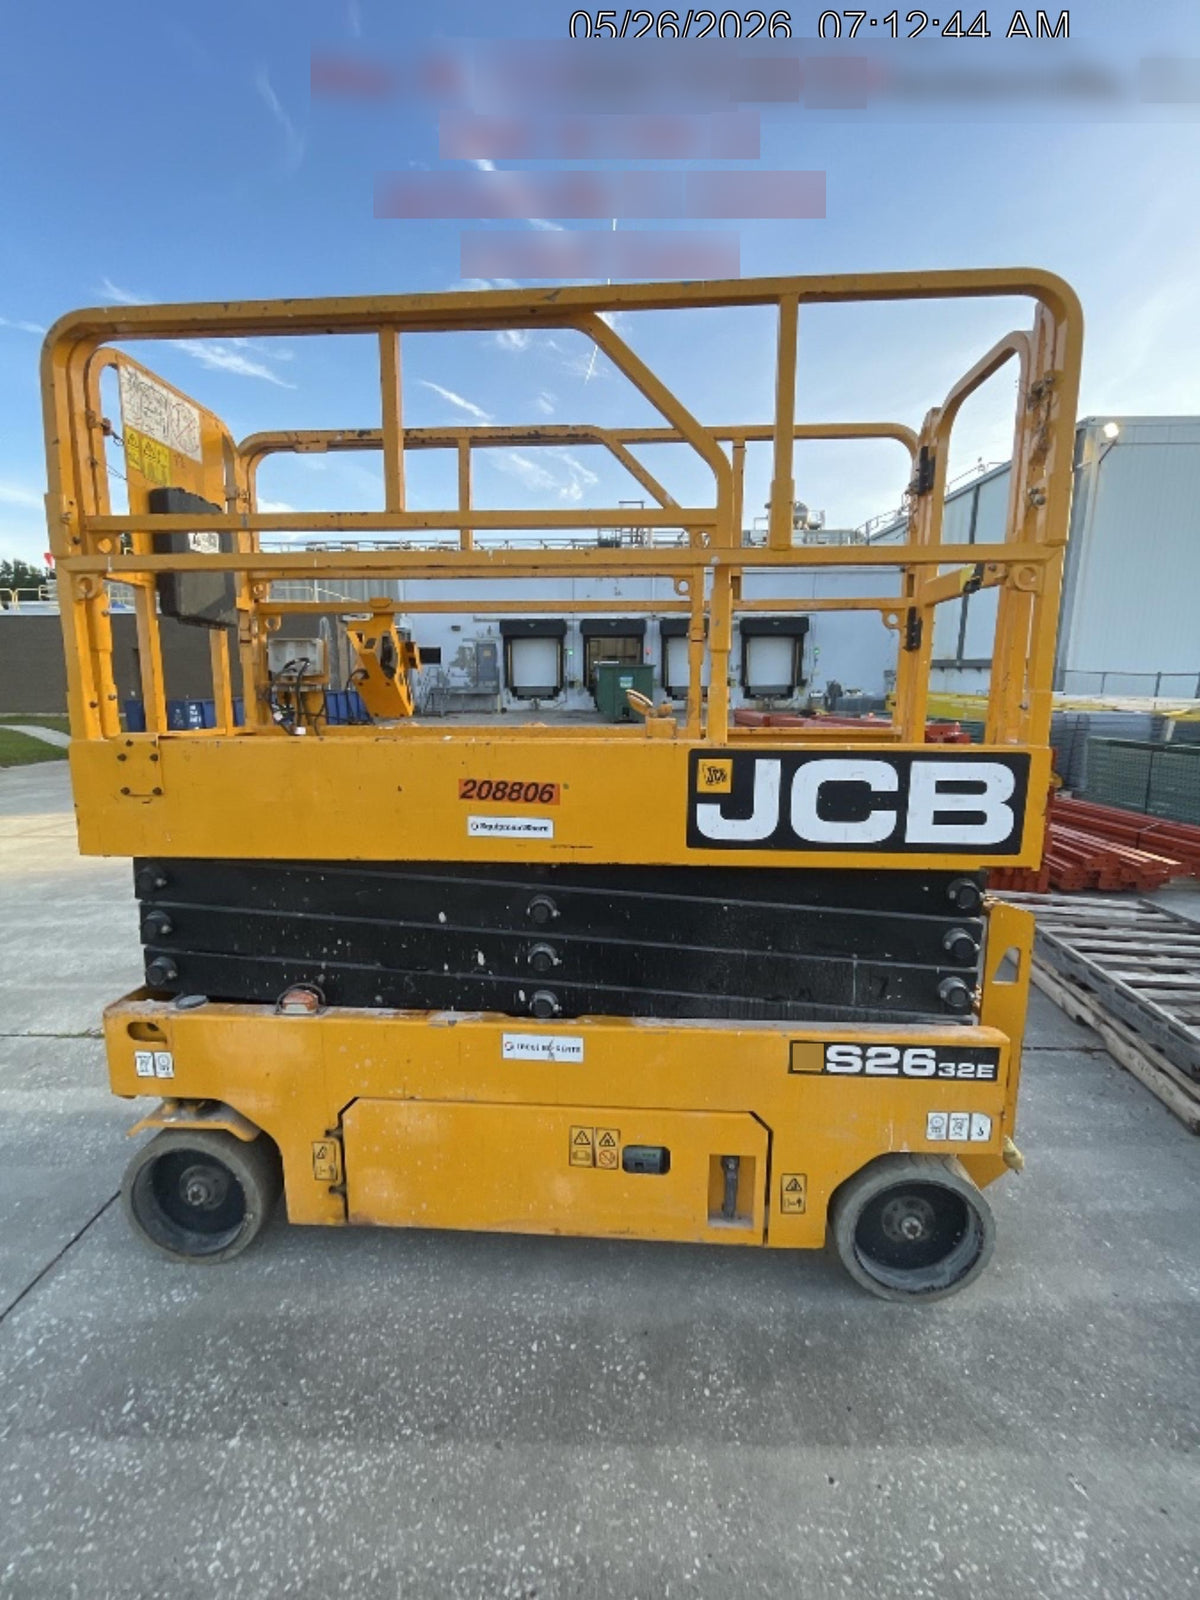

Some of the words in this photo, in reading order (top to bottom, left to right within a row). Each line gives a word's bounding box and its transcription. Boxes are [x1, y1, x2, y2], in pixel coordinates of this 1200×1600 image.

[460, 779, 555, 803] 208806
[696, 758, 1017, 845] JCB
[826, 1044, 936, 1077] S26
[938, 1062, 995, 1078] 32E
